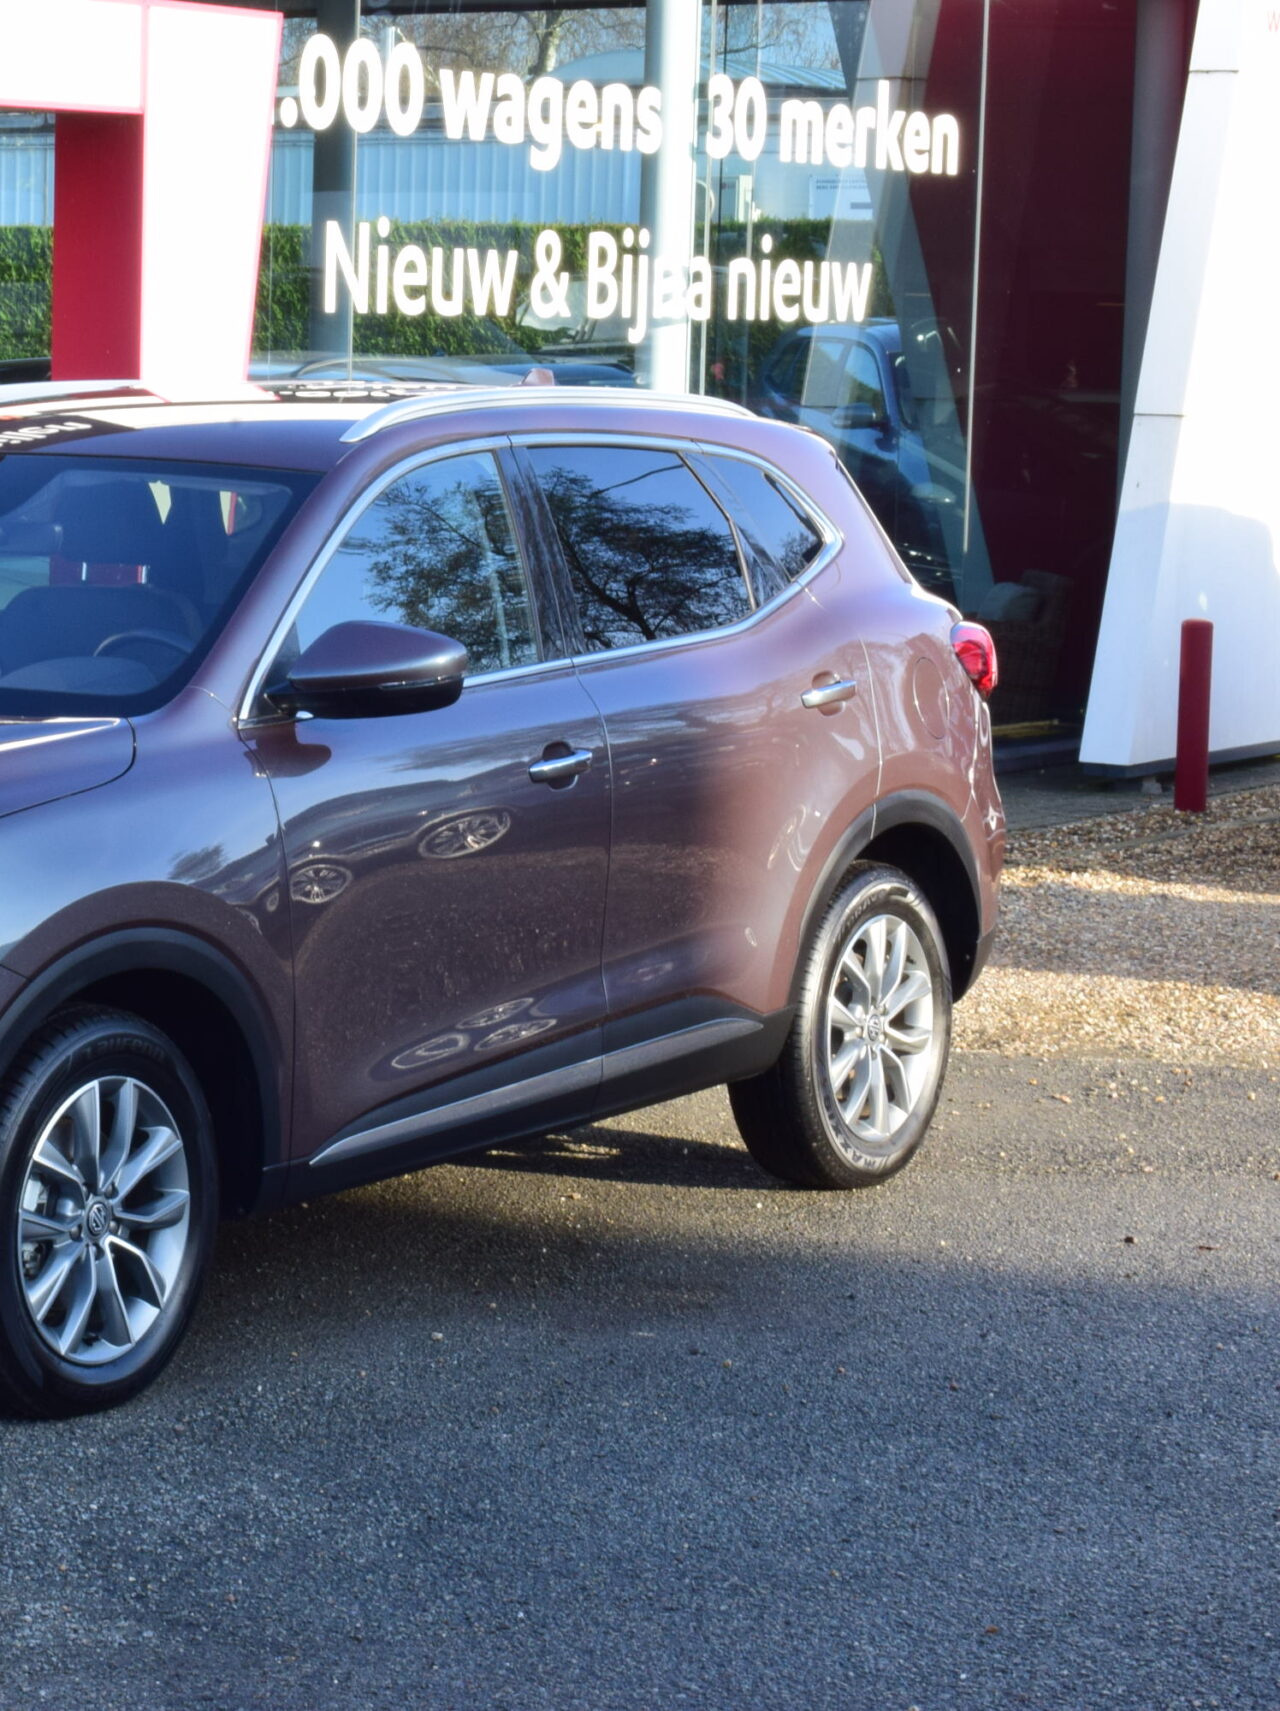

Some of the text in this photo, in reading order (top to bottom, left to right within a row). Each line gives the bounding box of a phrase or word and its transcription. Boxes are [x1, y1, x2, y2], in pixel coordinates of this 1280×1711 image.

[272, 33, 960, 176] .000 wagens 30 merken
[324, 216, 519, 317] Nieuw
[530, 229, 572, 319] &
[727, 233, 873, 322] nieuw
